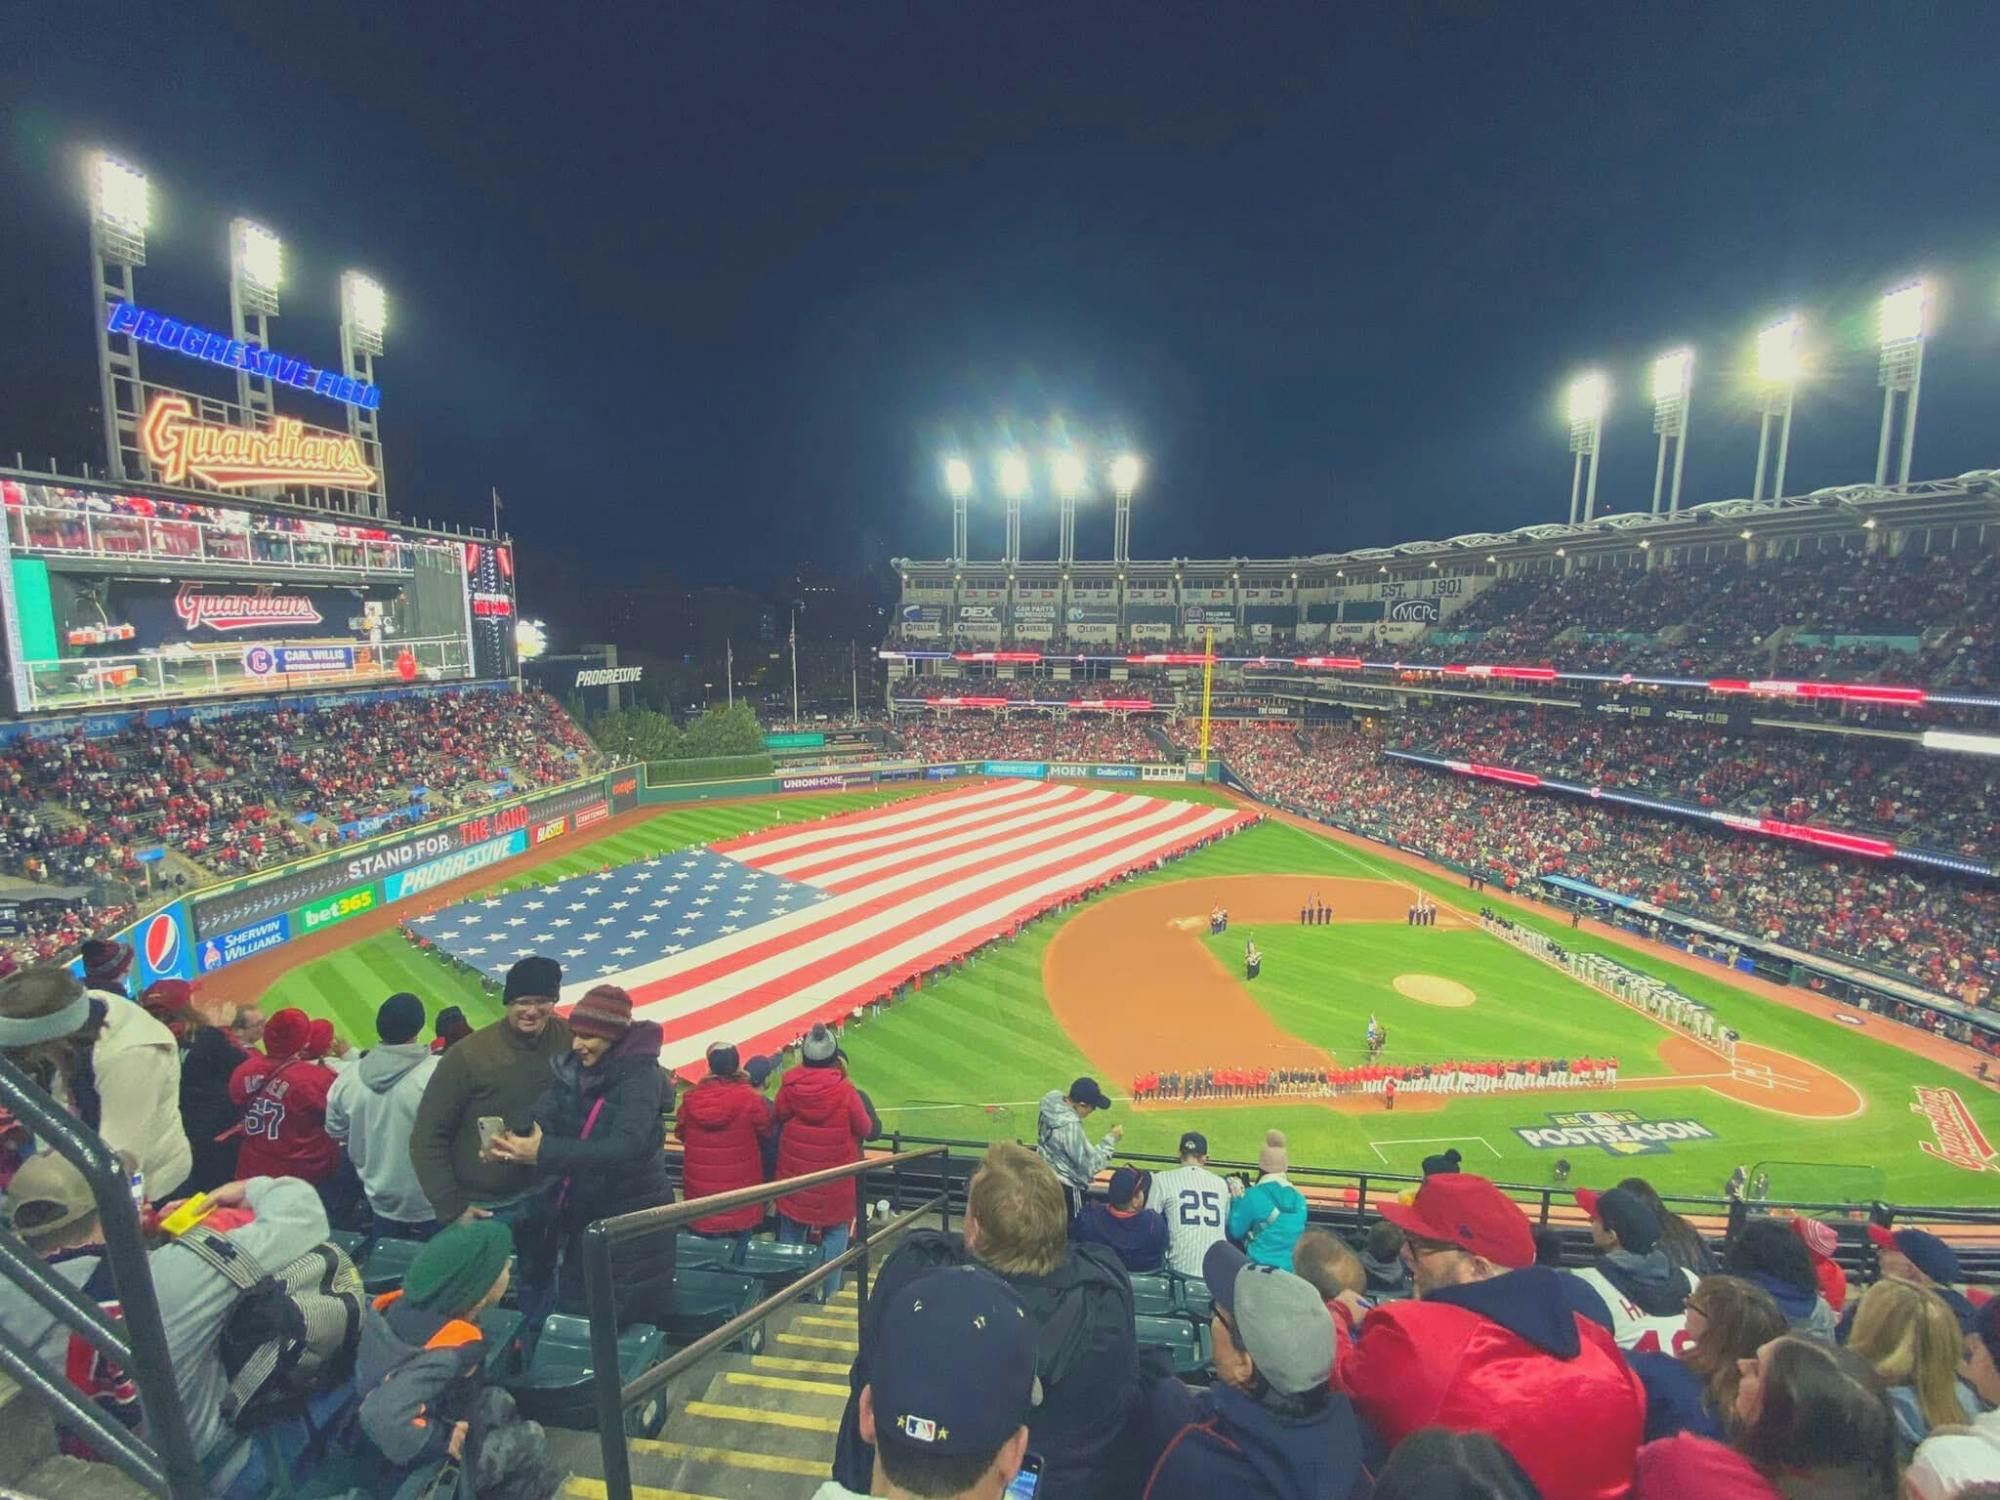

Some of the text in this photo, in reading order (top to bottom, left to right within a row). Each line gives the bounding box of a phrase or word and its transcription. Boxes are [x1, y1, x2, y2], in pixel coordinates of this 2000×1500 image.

[107, 303, 381, 410] PROGRESSIVE FIELD
[144, 397, 374, 487] Guardians
[175, 580, 323, 631] Guardians
[1432, 579, 1462, 595] 1901
[960, 607, 995, 617] DEX
[284, 649, 345, 661] CARL WILLIS
[576, 667, 643, 688] PROGRESSIVE
[1050, 766, 1086, 776] MOEN
[459, 805, 529, 846] THE LAND
[348, 834, 450, 879] STAND FOR
[399, 836, 514, 897] PROGRESSIVE
[305, 890, 372, 927] bet365
[224, 920, 280, 949] SHERWIN
[1518, 1120, 1713, 1147] POSTSEASON
[1179, 1189, 1220, 1227] 25
